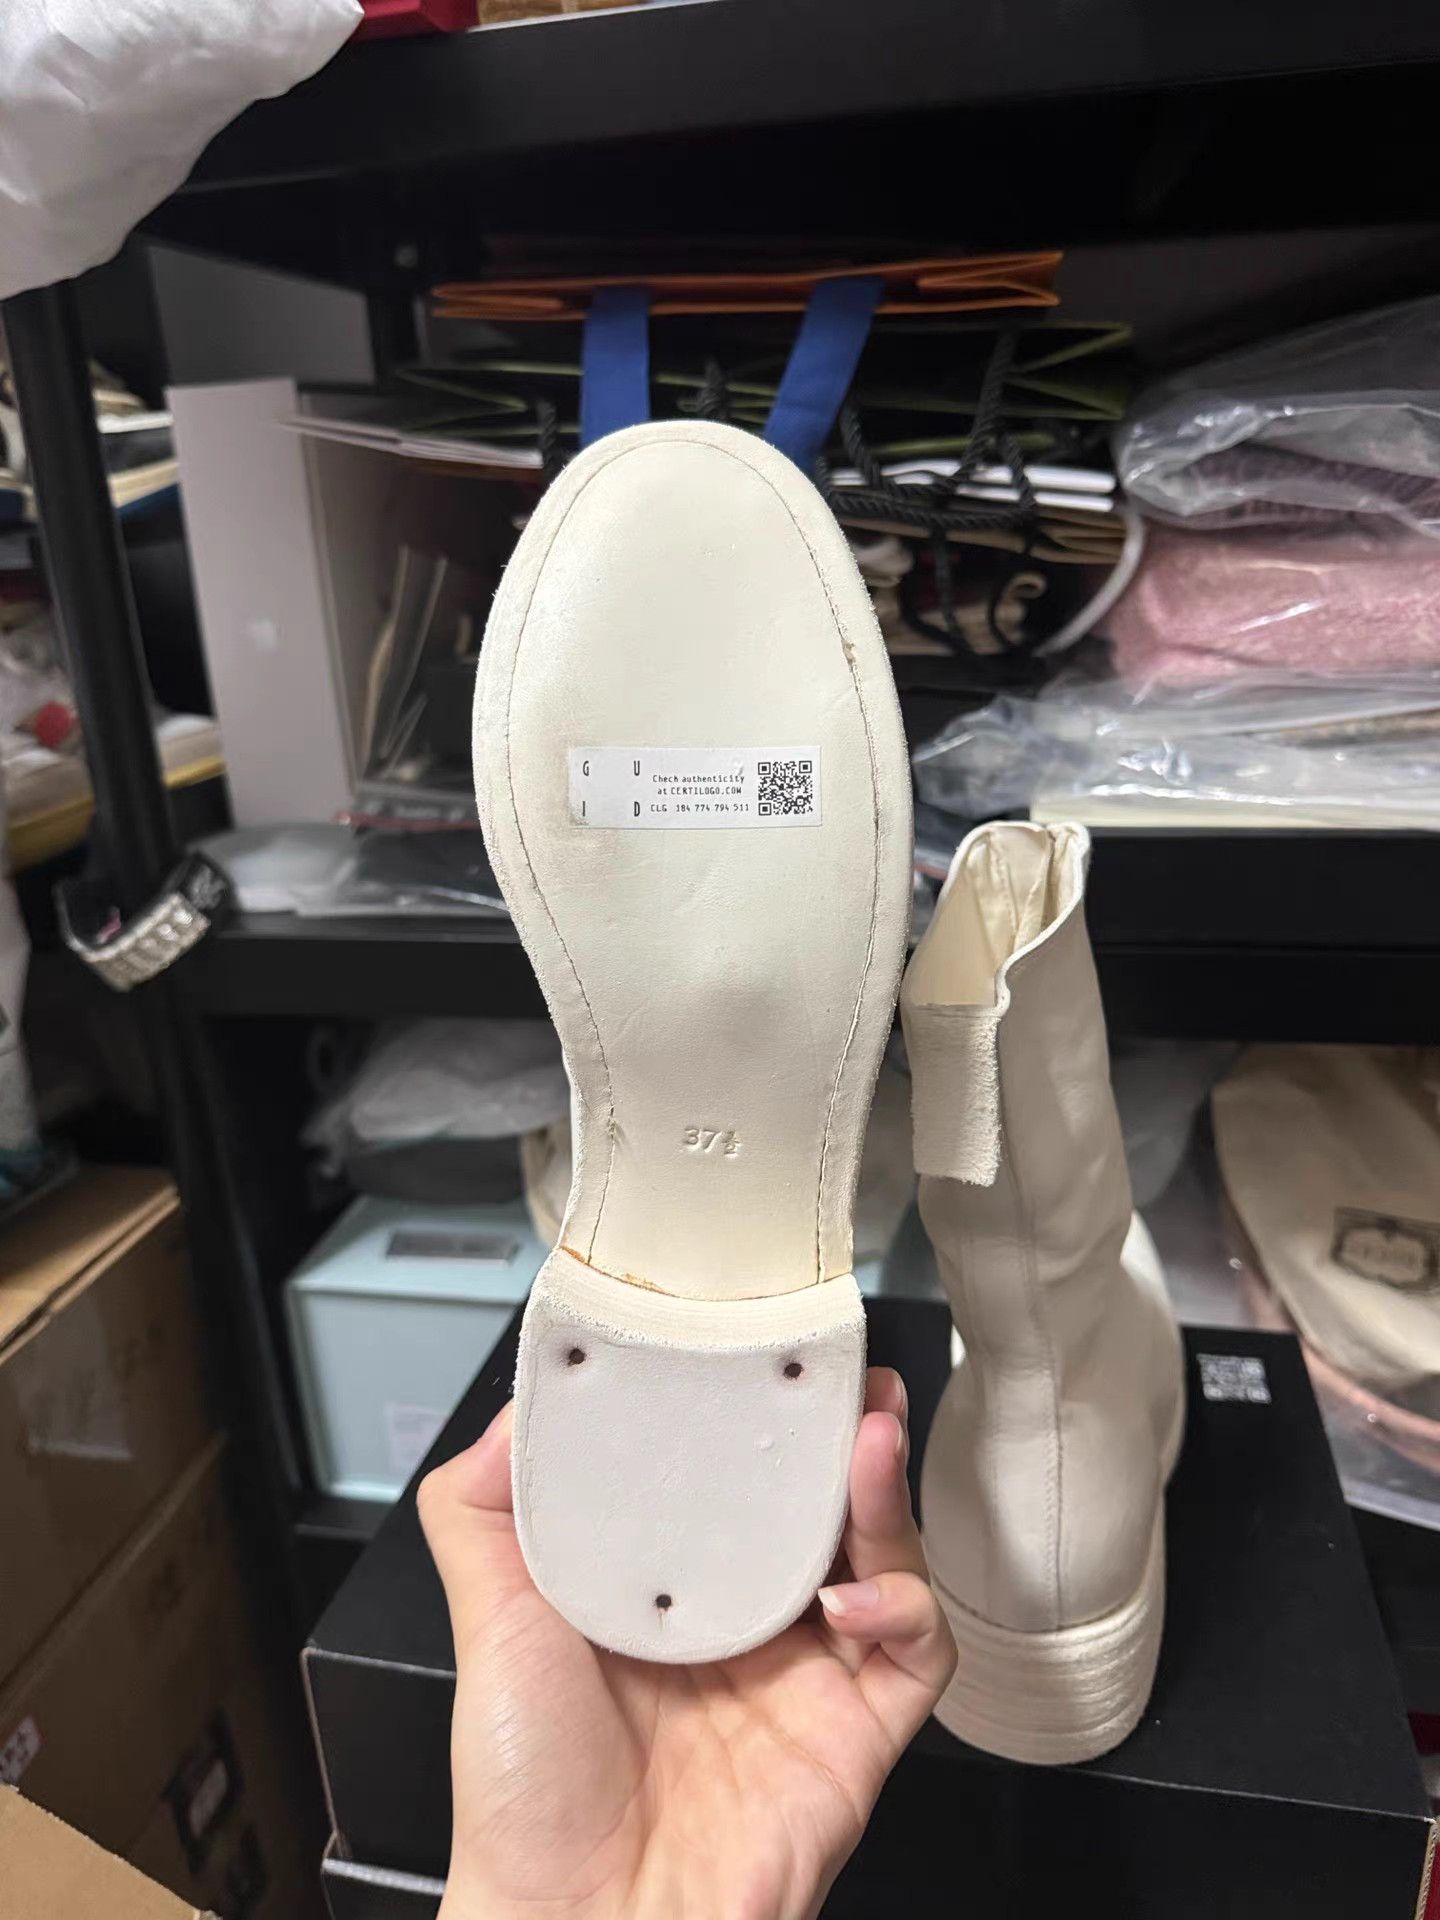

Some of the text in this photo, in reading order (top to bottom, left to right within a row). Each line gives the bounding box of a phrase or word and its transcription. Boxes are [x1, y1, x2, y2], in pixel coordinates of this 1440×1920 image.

[583, 760, 640, 776] G U
[682, 774, 745, 784] authenticity
[670, 786, 742, 795] CERTILOGO.COM
[634, 801, 640, 817] D
[650, 803, 749, 813] CLG 184 774 794 511
